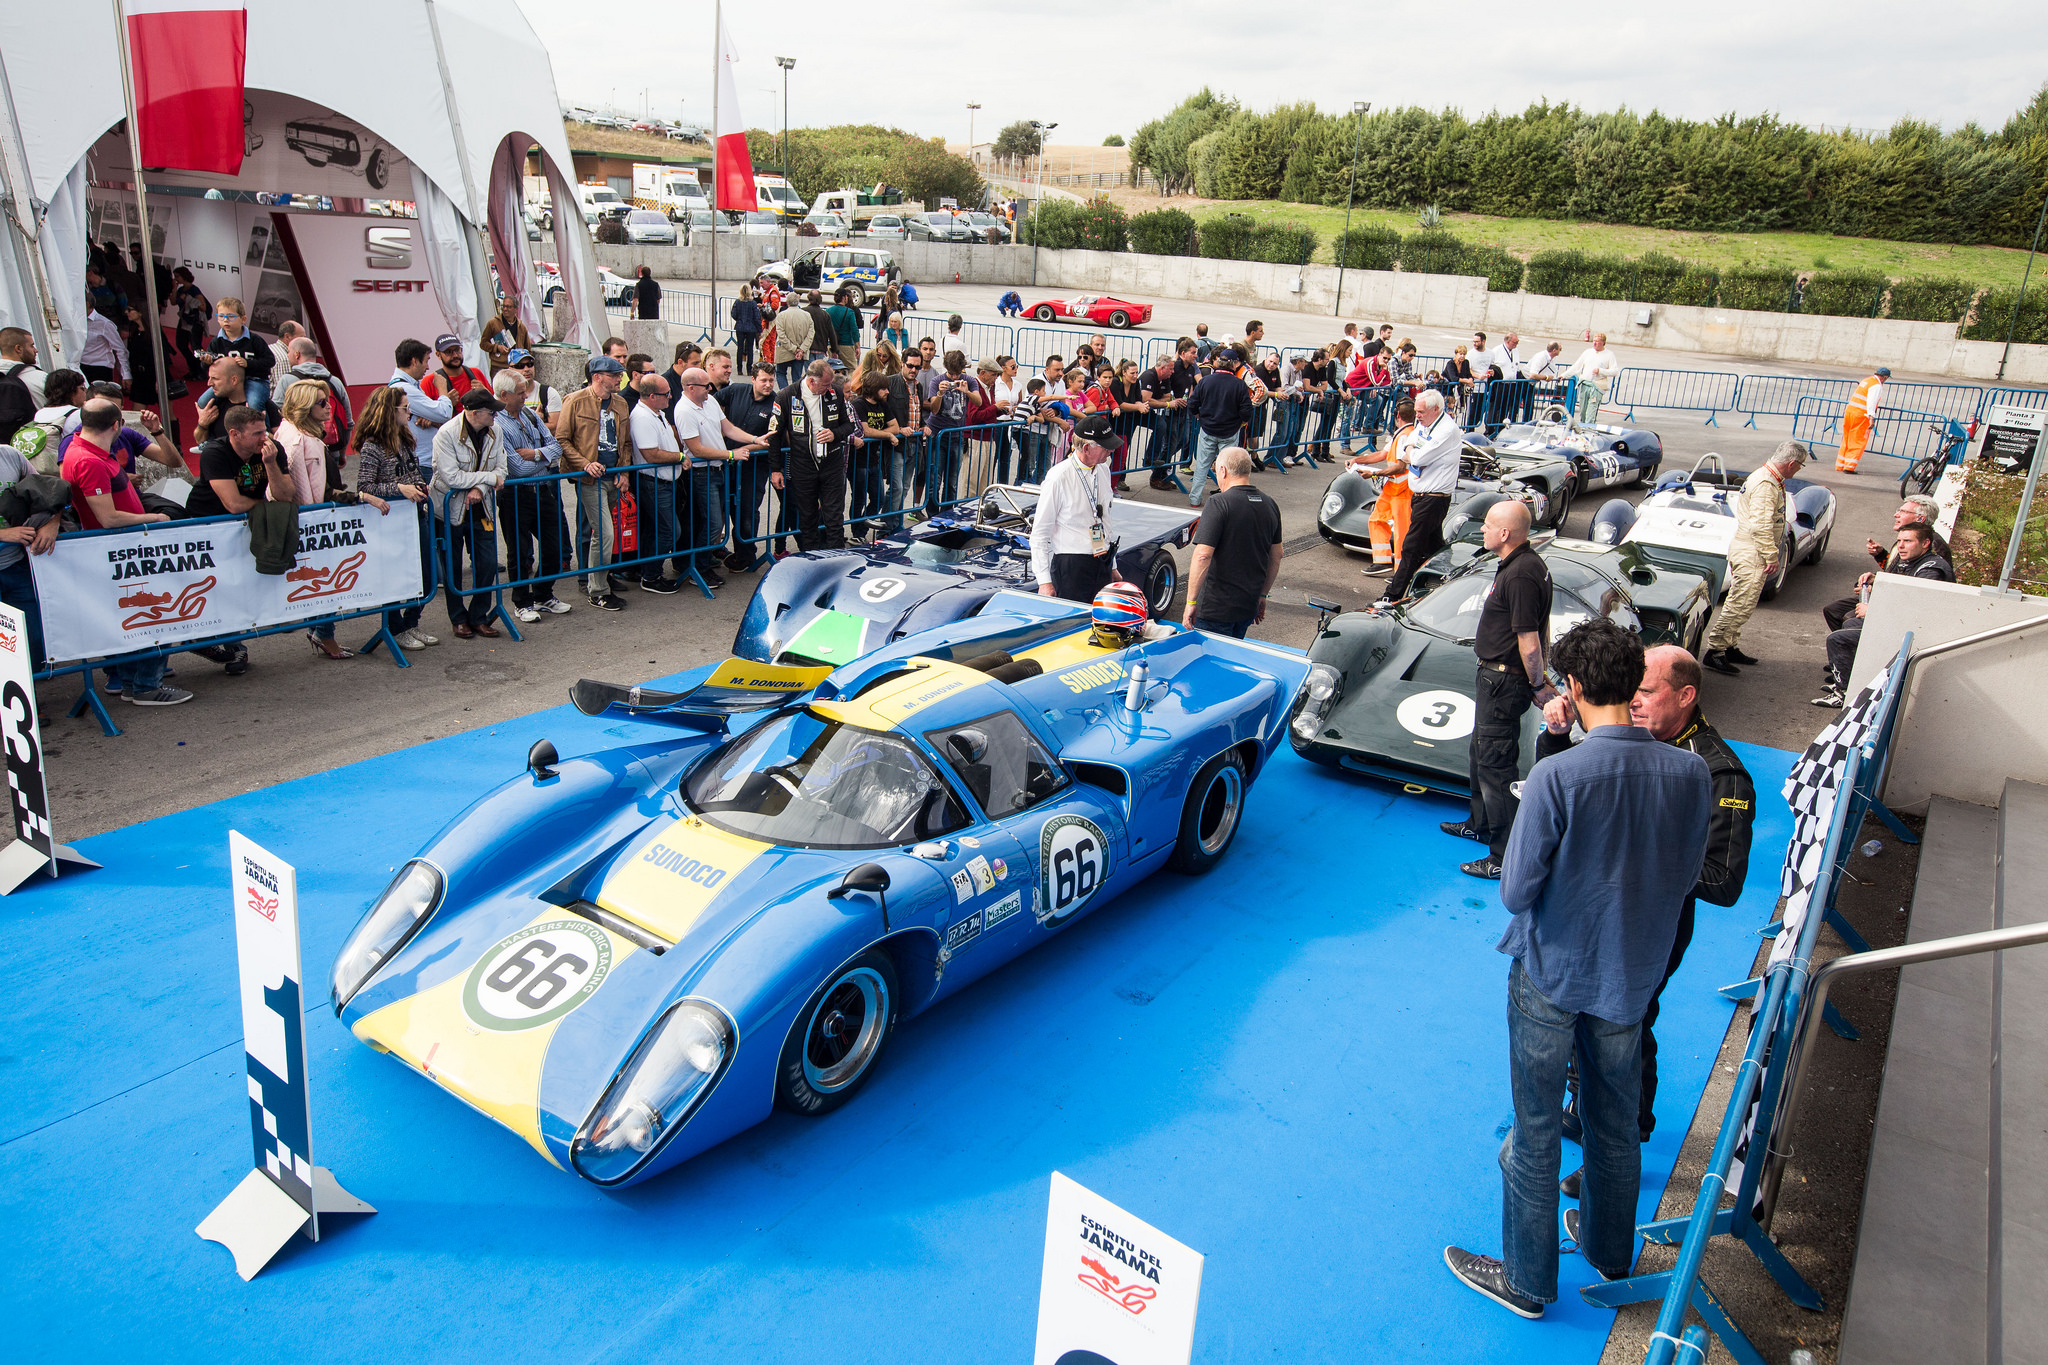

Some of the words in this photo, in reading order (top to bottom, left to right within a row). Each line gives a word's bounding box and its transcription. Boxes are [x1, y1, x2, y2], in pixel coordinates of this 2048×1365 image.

[183, 259, 240, 274] CUPRA
[854, 272, 876, 280] RACE
[352, 279, 429, 292] SEAT
[1604, 456, 1617, 479] 29
[297, 530, 367, 553] ARAMA
[298, 521, 336, 537] PÍRITU
[341, 518, 365, 531] DEL
[107, 543, 179, 563] ESPÍRITU
[185, 540, 214, 554] DEL
[111, 552, 216, 581] JARAMA
[866, 579, 899, 598] 9
[123, 631, 151, 640] FESTIVAL
[182, 619, 222, 630] VELOCIDAD
[729, 677, 744, 686] M.
[749, 679, 804, 688] DONOVAN
[1058, 659, 1128, 694] SUNOCO
[903, 701, 920, 710] M.
[918, 681, 964, 703] DONOVAN
[2, 680, 41, 773] 3
[1422, 702, 1457, 728] 3
[1722, 798, 1748, 809] Sabelt
[1042, 833, 1051, 883] MASTERS
[1049, 816, 1082, 835] HISTORIC
[1084, 820, 1108, 856] RACING
[243, 855, 267, 876] ESPÍRITU
[268, 872, 278, 883] DEL
[643, 843, 726, 888] SUNOCO
[982, 867, 991, 884] 3
[1054, 838, 1095, 909] 66
[245, 865, 279, 895] JARAMA
[987, 897, 1019, 920] Masters
[500, 921, 563, 949] MASTERS
[565, 921, 609, 954] HISTORIC
[486, 939, 588, 1010] 66
[582, 951, 612, 994] RACING
[1080, 1226, 1160, 1285] JARAMA
[1081, 1213, 1135, 1252] ESPÍRITU
[1139, 1248, 1163, 1270] DEL
